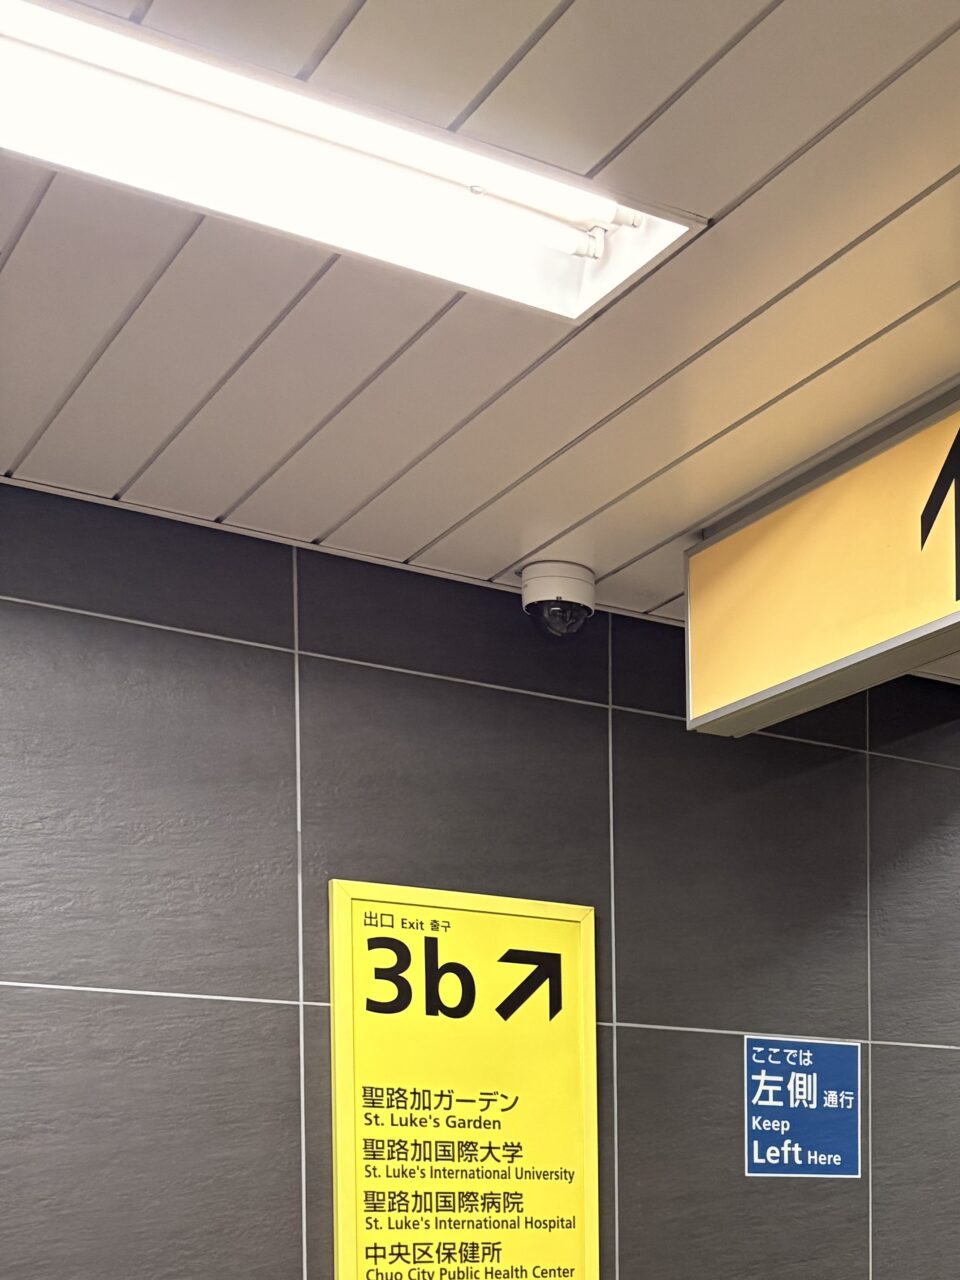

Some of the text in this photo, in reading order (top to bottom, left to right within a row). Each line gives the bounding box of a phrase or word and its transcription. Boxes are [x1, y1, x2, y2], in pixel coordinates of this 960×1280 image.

[363, 911, 451, 932] 出口 Exit 출구
[365, 936, 476, 1019] 3b
[751, 1046, 814, 1067] ここでは
[361, 1086, 519, 1112] 聖路加ガーデン
[751, 1069, 855, 1110] 左側 通行
[363, 1112, 502, 1130] St. Luke's Garden
[751, 1115, 791, 1136] Keep
[362, 1138, 524, 1164] 聖路加国際大学
[752, 1138, 842, 1166] Left Here
[364, 1165, 575, 1184] St. Luke's International University
[363, 1190, 524, 1214] 聖路加国際病院
[365, 1216, 576, 1233] St. Luke's International Hospital
[364, 1241, 502, 1266] 中央区保健所
[439, 1266, 481, 1280] Public
[484, 1265, 528, 1280] Health
[532, 1265, 576, 1279] Center
